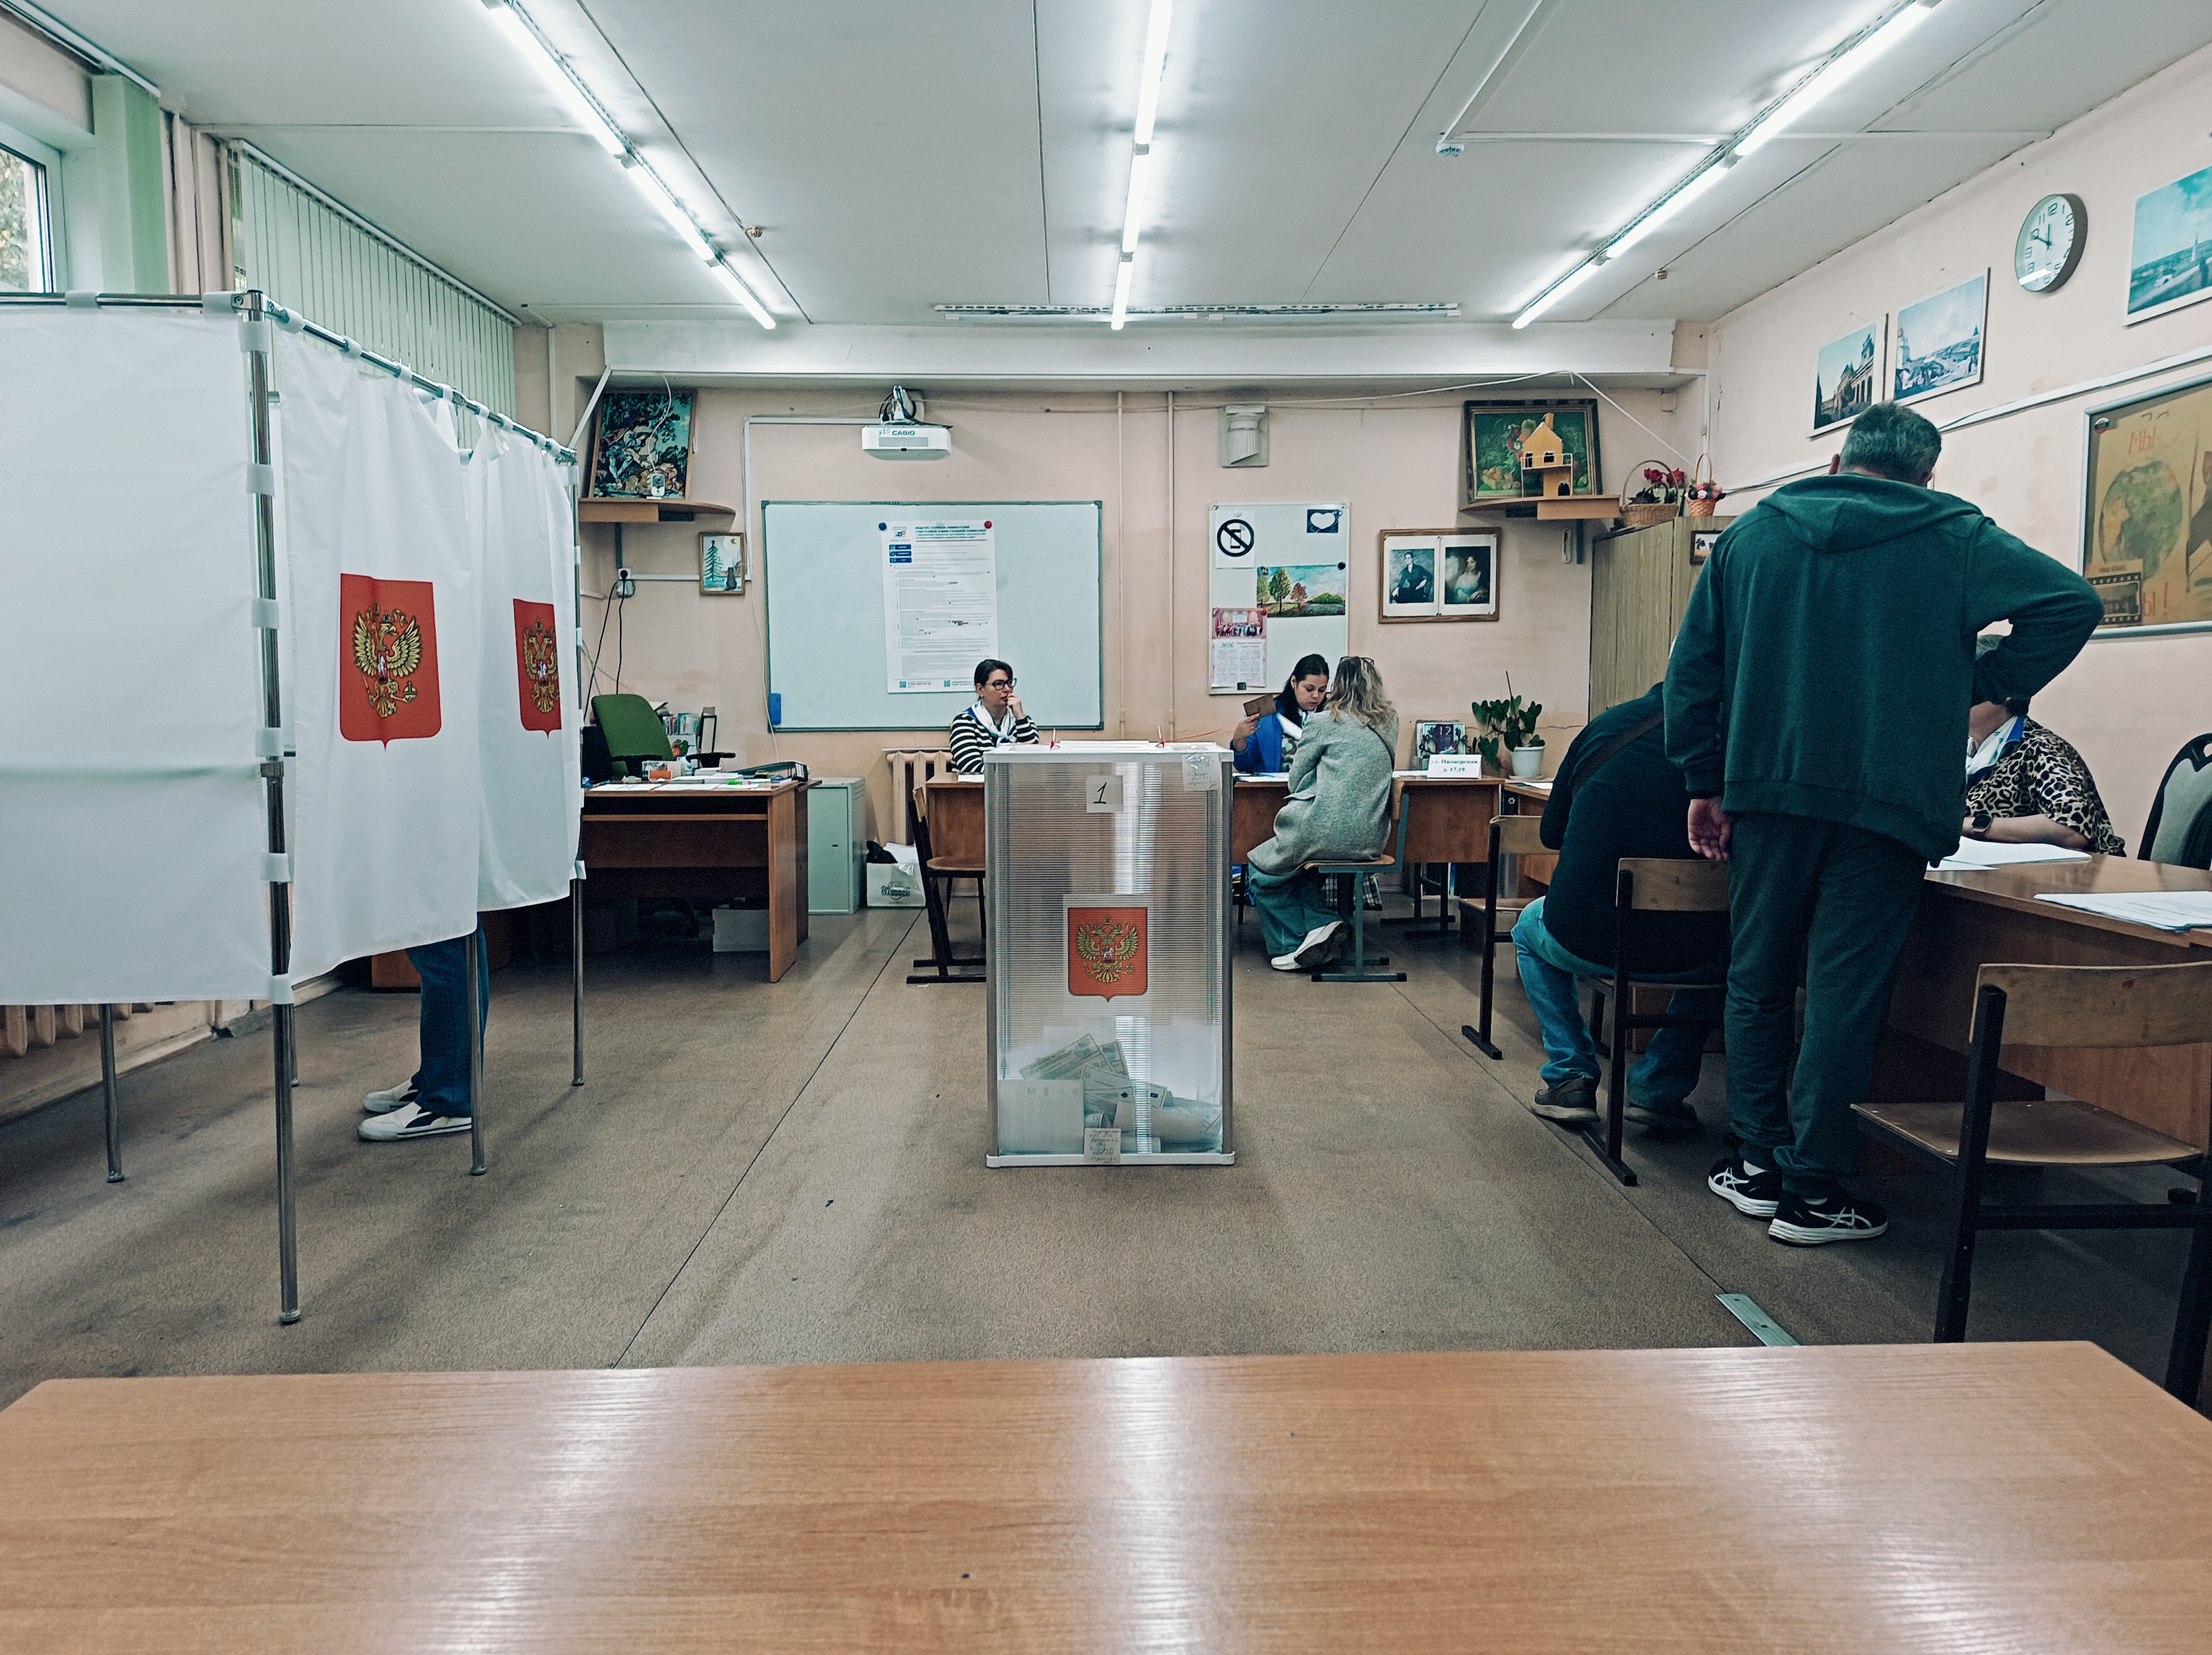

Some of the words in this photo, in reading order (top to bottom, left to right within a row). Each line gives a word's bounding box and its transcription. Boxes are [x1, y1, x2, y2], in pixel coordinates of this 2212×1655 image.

[2048, 202, 2058, 216] 12
[2039, 213, 2046, 226] 11
[2065, 213, 2074, 226] 2
[1093, 782, 1107, 804] 1
